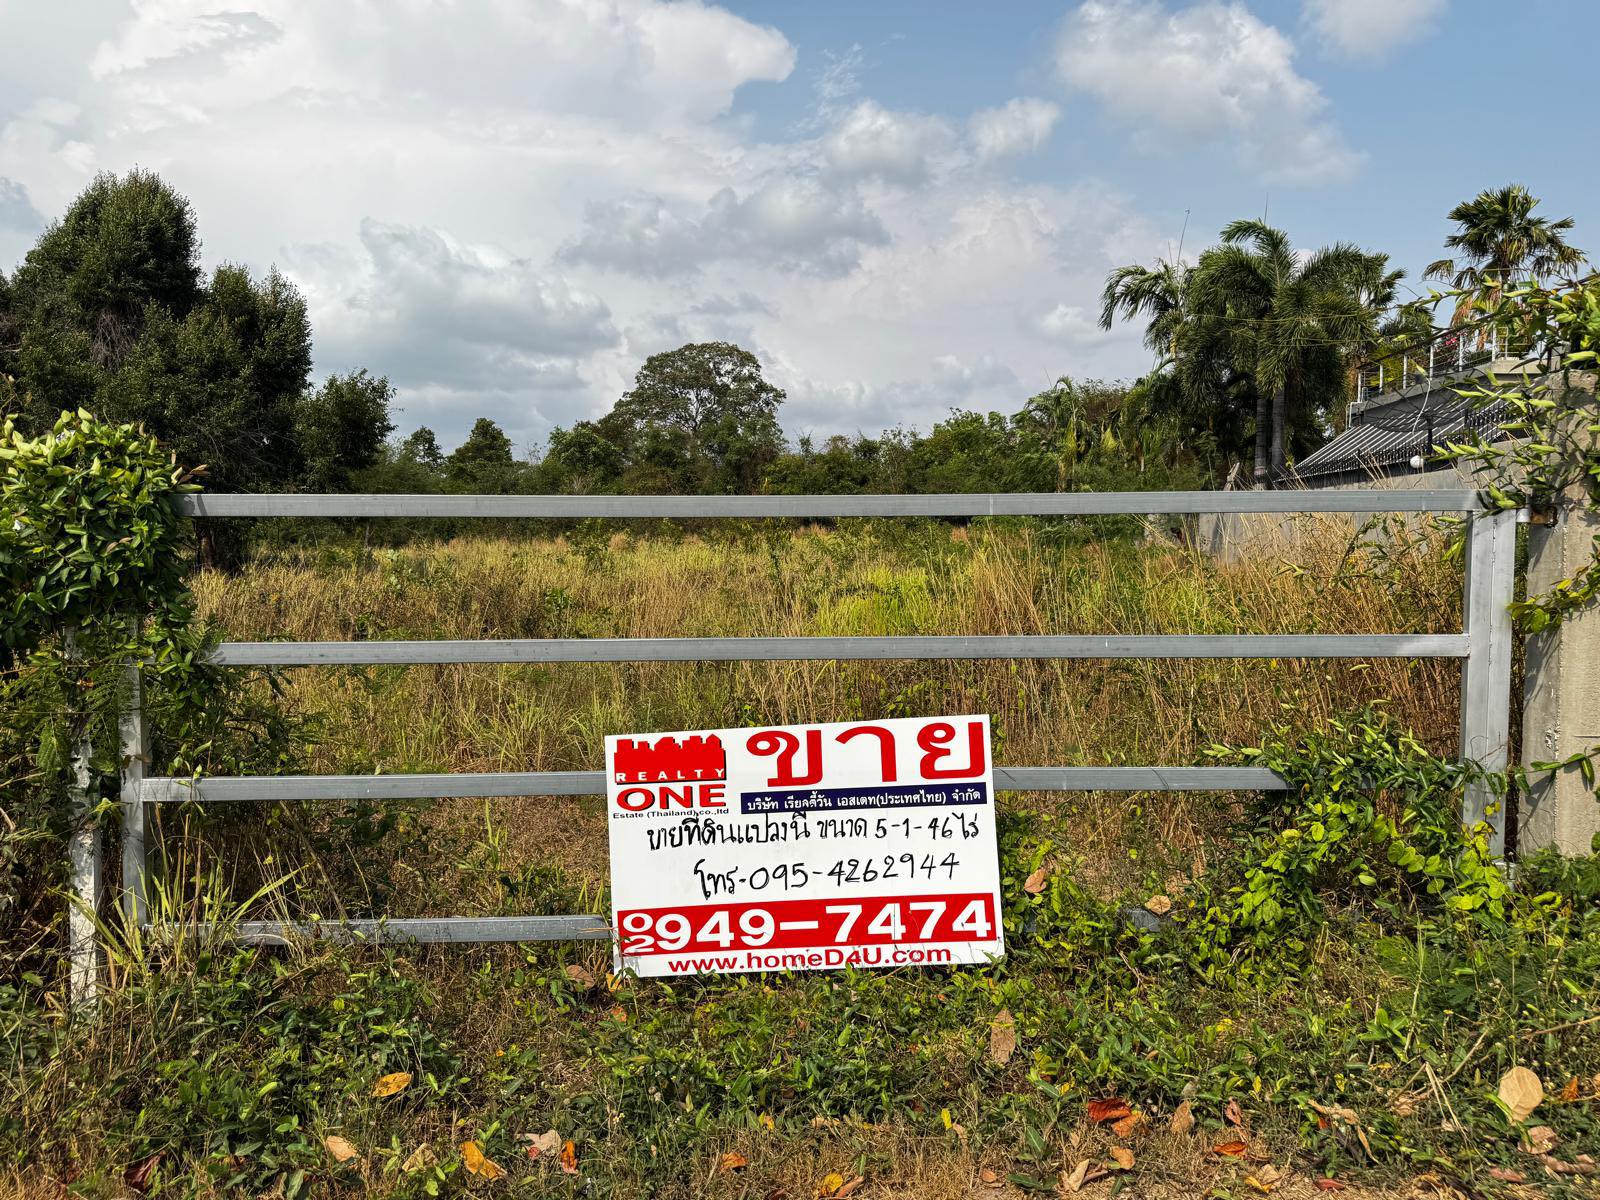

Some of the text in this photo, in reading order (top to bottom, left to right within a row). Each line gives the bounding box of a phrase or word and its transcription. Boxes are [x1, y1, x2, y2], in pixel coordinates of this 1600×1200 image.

[746, 722, 985, 787] ขาย
[615, 767, 725, 783] REALTY
[616, 783, 727, 811] ONE
[747, 796, 779, 811] บริษัท
[951, 788, 981, 802] จำกัด
[612, 810, 644, 819] Estate
[816, 817, 867, 840] ขนาด
[667, 947, 951, 973] www.homeD4U.com
